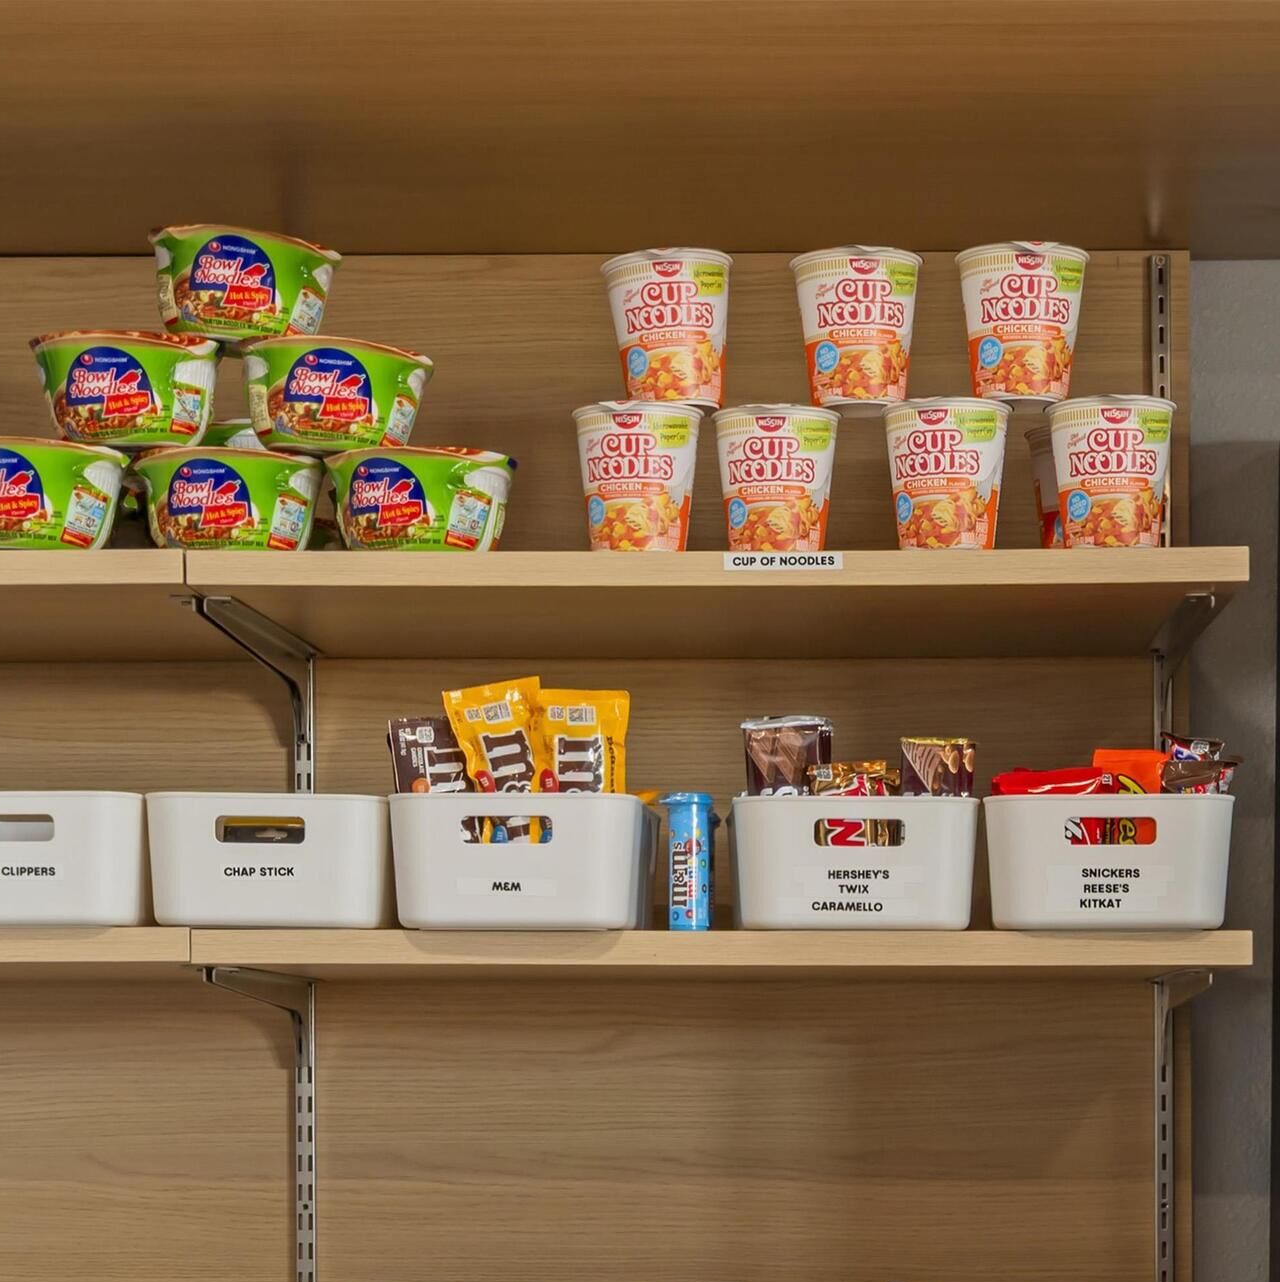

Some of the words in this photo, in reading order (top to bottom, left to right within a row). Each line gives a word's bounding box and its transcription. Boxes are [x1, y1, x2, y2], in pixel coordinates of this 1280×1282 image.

[199, 255, 243, 272] Bowl
[194, 268, 261, 287] Noodles
[1000, 274, 1058, 298] CUP
[641, 281, 699, 306] CUP
[981, 296, 1071, 324] NOODLES
[625, 302, 713, 334] NOODLES
[997, 325, 1041, 334] CHICKEN
[642, 331, 687, 342] CHICKEN
[295, 367, 340, 383] Bowl
[290, 377, 358, 398] Noodles
[1087, 428, 1145, 452] CUP
[743, 436, 800, 461] CUP
[1070, 449, 1157, 476] NOODLES
[728, 458, 815, 485] NOODLES
[1085, 478, 1128, 487] CHICKEN
[741, 486, 783, 495] CHICKEN
[732, 557, 757, 567] CUP
[761, 557, 776, 567] OF
[779, 556, 835, 567] NOODLES
[1, 866, 56, 877] CLIPPERS
[224, 866, 256, 877] CHAP
[259, 866, 295, 877] STICK
[827, 870, 890, 880] HERSHEY'S
[1081, 868, 1140, 878] SNICKERS
[838, 885, 869, 894] TWIX
[1083, 883, 1130, 893] REESE'S
[812, 901, 883, 912] CARAMELLO
[1080, 899, 1122, 908] KITKAT
